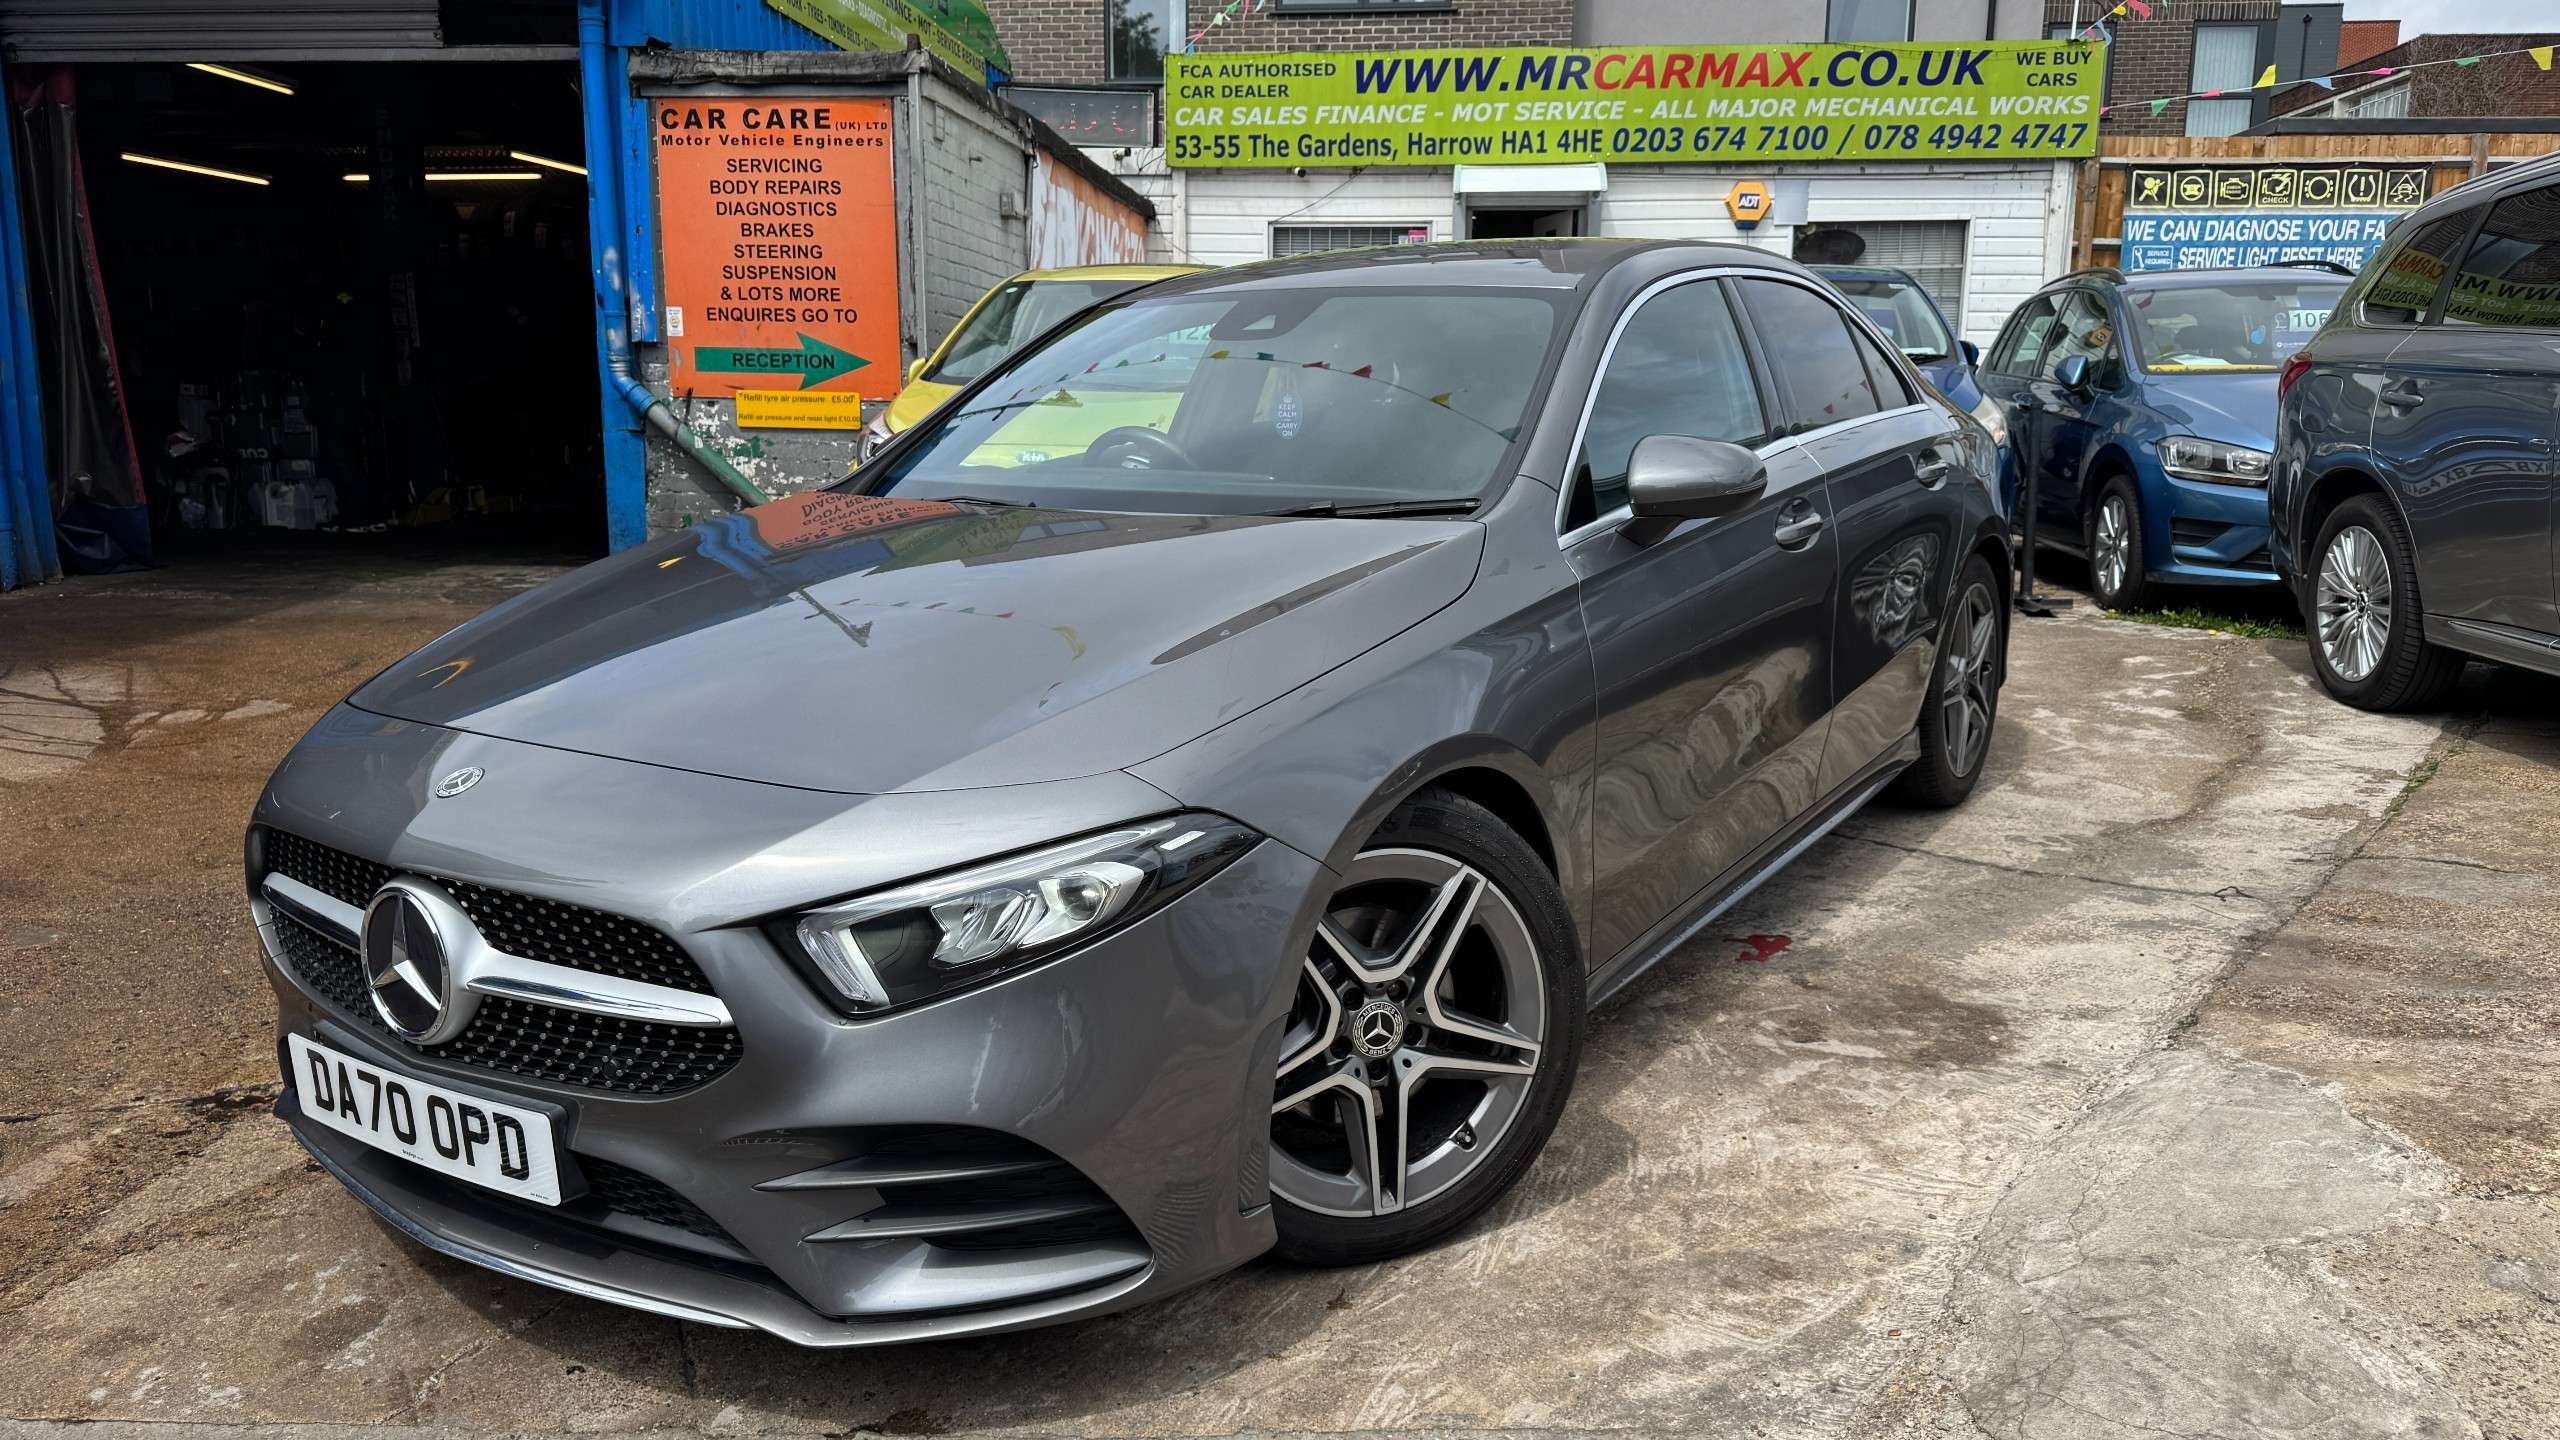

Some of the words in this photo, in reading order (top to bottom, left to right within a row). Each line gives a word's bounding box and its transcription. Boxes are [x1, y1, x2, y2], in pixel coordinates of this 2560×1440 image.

[2016, 52, 2046, 66] WE
[2053, 50, 2093, 66] BUY
[1180, 64, 1213, 79] FCA
[1219, 62, 1337, 78] AUTHORISED
[1355, 49, 1994, 95] WWW.MRCARMAX.CO.UK
[2026, 72, 2078, 88] CARS
[1180, 85, 1215, 99] CAR
[1222, 84, 1289, 99] DEALER
[1174, 107, 1224, 127] CAR
[1231, 106, 1308, 126] SALES
[1315, 104, 1428, 125] FINANCE
[1452, 102, 1509, 122] MOT
[1514, 100, 1627, 121] SERVICE
[1650, 99, 1698, 119] ALL
[1706, 97, 1795, 119] MAJOR
[1803, 96, 1978, 117] MECHANICAL
[1989, 95, 2090, 115] WORKS
[661, 108, 727, 130] CAR
[742, 108, 832, 130] CARE
[835, 121, 861, 131] (UK)
[866, 121, 888, 130] LTD
[661, 135, 711, 146] Motor
[719, 134, 785, 146] Vehicle
[793, 134, 884, 149] Engineers
[1175, 134, 1241, 158] 53-55
[1248, 133, 1290, 158] The
[1297, 132, 1399, 161] Gardens,
[1407, 132, 1492, 156] Harrow
[1501, 130, 1548, 155] HA1
[1557, 128, 1603, 154] 4HE
[1612, 126, 1684, 153] 0203
[1693, 125, 1747, 151] 674
[1756, 124, 1829, 151] 7100
[1864, 124, 1919, 150] 078
[1928, 123, 2002, 150] 4942
[2011, 122, 2088, 150] 4747
[727, 158, 823, 174] SERVICING
[709, 180, 760, 195] BODY
[765, 180, 842, 195] REPAIRS
[1738, 194, 1760, 208] ADT
[2262, 196, 2290, 204] CHECK
[716, 201, 838, 217] DIAGNOSTICS
[741, 223, 815, 238] BRAKES
[2127, 219, 2157, 241] WE
[2160, 219, 2202, 241] CAN
[2204, 219, 2304, 241] DIAGNOSE
[2308, 218, 2360, 241] YOUR
[734, 244, 823, 260] STEERING
[2177, 246, 2236, 269] SERVICE
[2237, 247, 2279, 268] LIGHT
[2280, 246, 2325, 263] RESET
[2326, 246, 2364, 270] HERE
[722, 265, 837, 280] SUSPENSION
[720, 287, 732, 301] &
[738, 287, 784, 301] LOTS
[789, 287, 841, 302] MORE
[706, 307, 796, 323] ENQUIRES
[802, 308, 829, 323] GO
[834, 309, 858, 324] TO
[732, 353, 835, 369] RECEPTION
[743, 393, 763, 401] Refill
[764, 394, 778, 402] tyre
[792, 395, 825, 404] pressure
[1362, 1003, 1396, 1017] MERCEDES
[1369, 1048, 1387, 1056] BENZ
[306, 1047, 417, 1146] DA70
[426, 1094, 530, 1181] OPD
